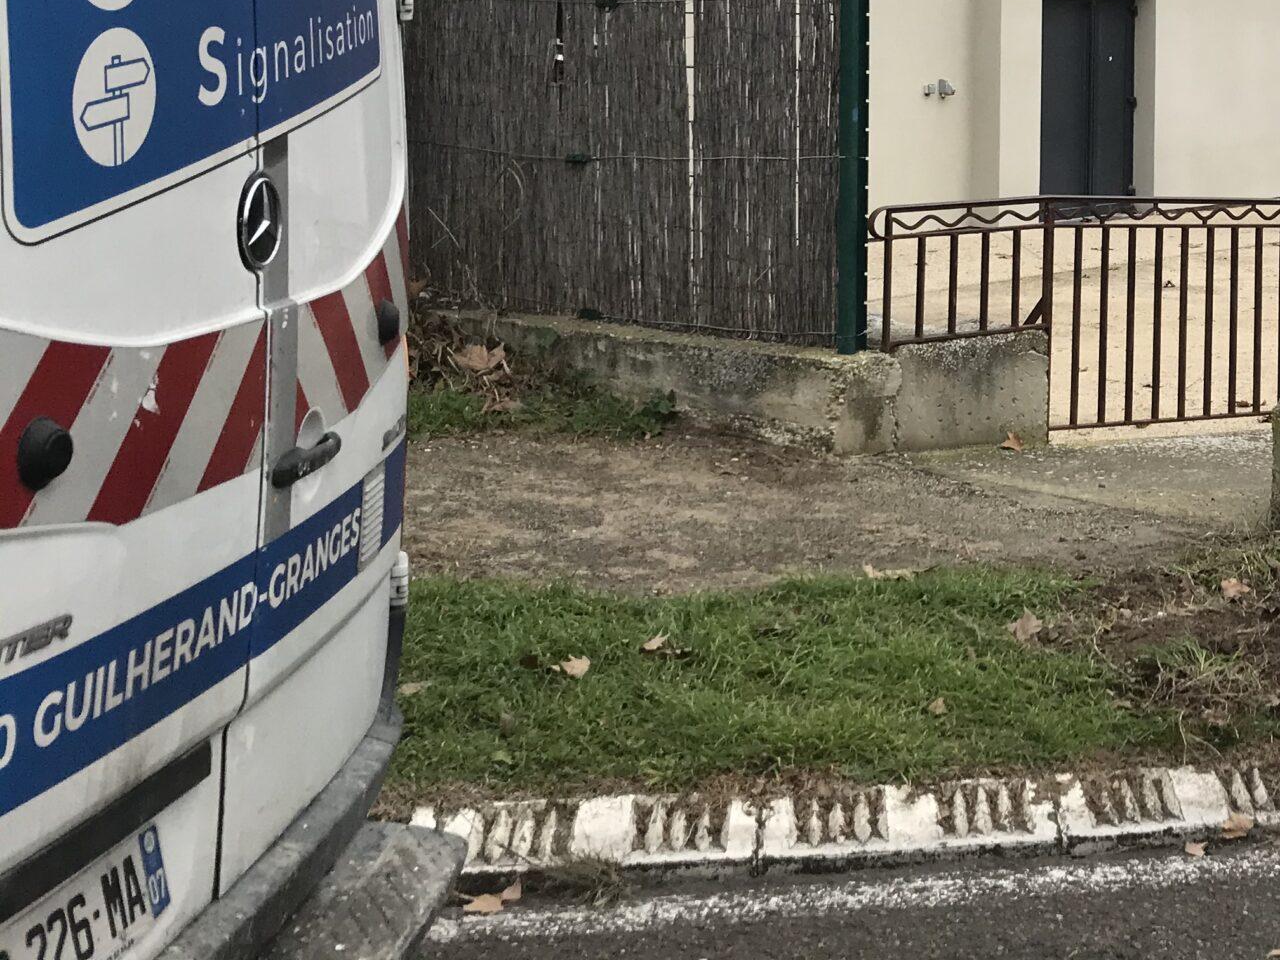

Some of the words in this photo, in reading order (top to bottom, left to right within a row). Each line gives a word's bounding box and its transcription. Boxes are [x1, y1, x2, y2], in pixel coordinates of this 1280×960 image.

[198, 7, 374, 106] Signalisation
[33, 507, 361, 748] GUILHERAND-GRANGES
[148, 867, 166, 905] 07
